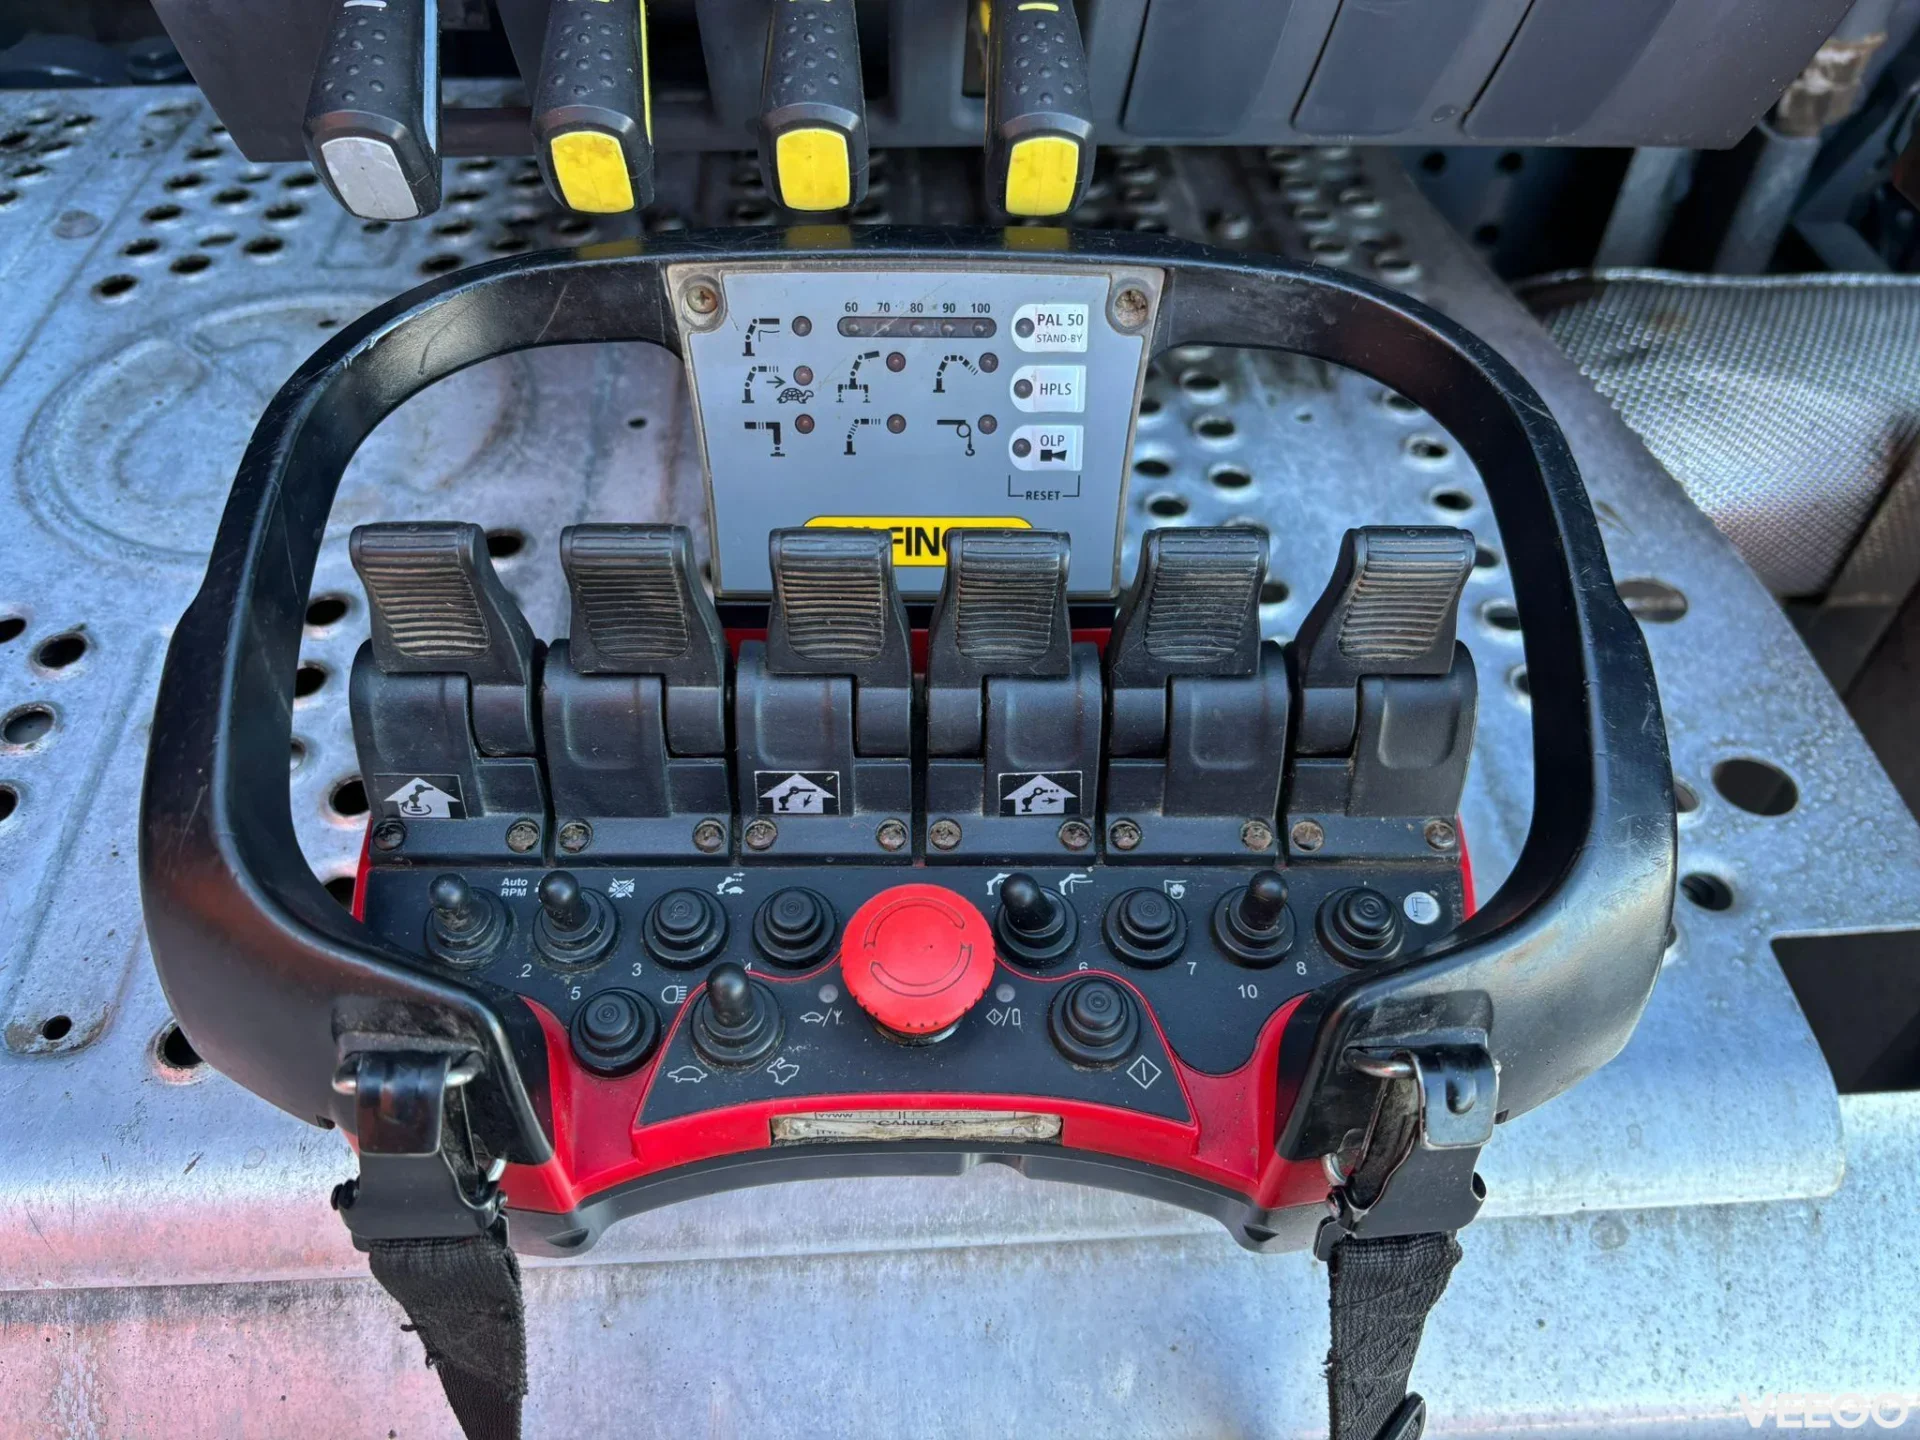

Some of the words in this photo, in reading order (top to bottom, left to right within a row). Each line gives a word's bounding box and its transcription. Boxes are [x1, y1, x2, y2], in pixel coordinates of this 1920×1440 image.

[844, 302, 858, 313] 60
[877, 302, 890, 313] 70
[910, 302, 923, 313] 80
[942, 302, 956, 313] 90
[971, 302, 991, 314] 100
[1037, 313, 1063, 326] PAL
[1067, 313, 1084, 326] 50
[1036, 334, 1083, 343] STAND-BY
[1040, 383, 1072, 396] HPLS
[1040, 434, 1065, 447] OLP
[1025, 490, 1061, 501] RESET
[501, 877, 528, 887] Auto
[500, 887, 527, 897] RPM
[520, 963, 532, 978] 2
[631, 962, 642, 977] 3
[1186, 961, 1197, 976] 7
[1296, 961, 1307, 976] 8
[570, 986, 581, 1000] 5
[1237, 984, 1258, 999] 10
